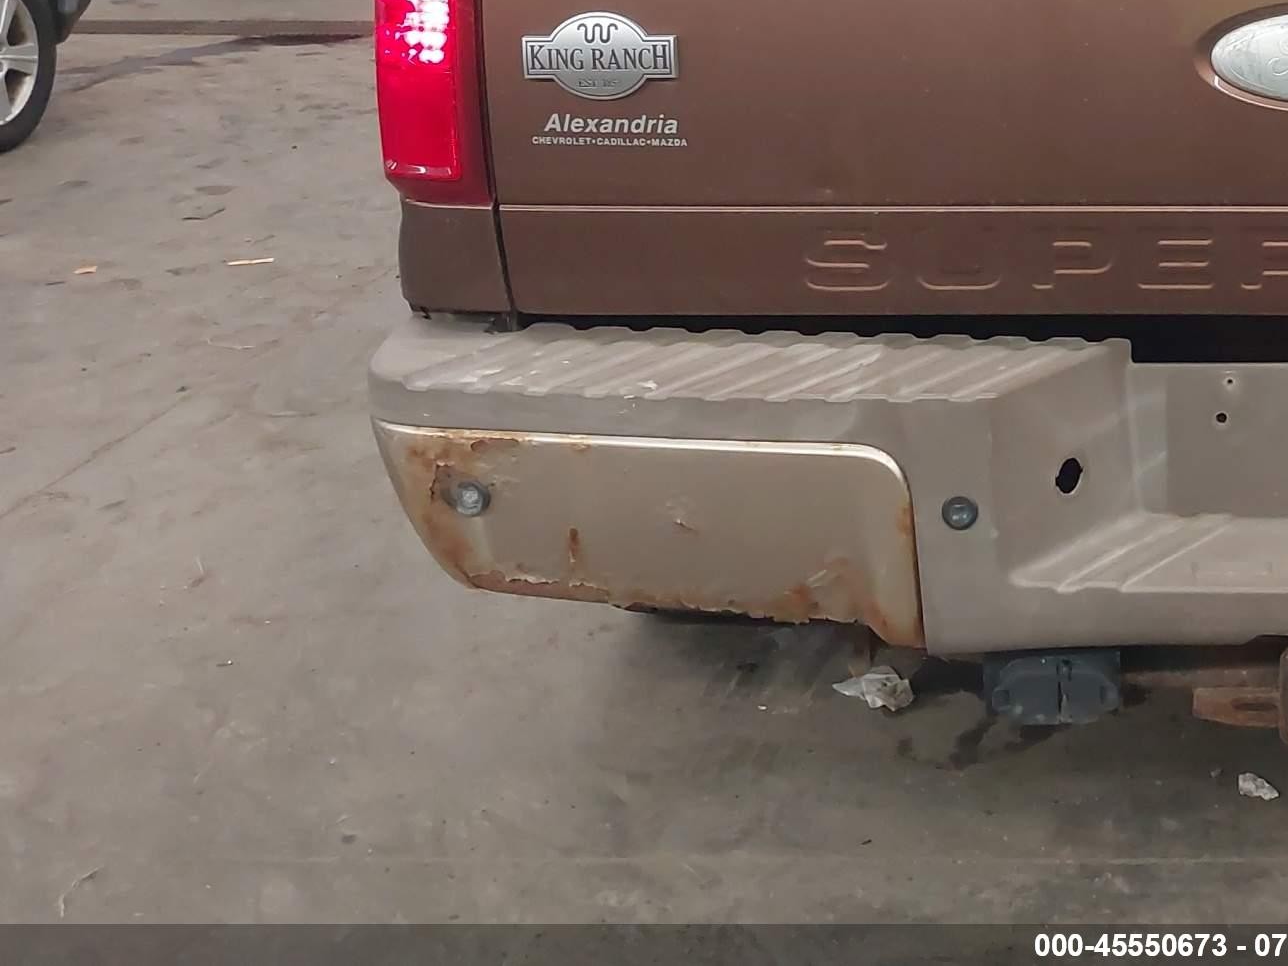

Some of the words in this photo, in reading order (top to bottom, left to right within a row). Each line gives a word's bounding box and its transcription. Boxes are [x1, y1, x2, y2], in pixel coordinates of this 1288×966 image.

[529, 44, 584, 71] KING
[591, 44, 669, 71] RANCH
[543, 113, 679, 135] Alexandria
